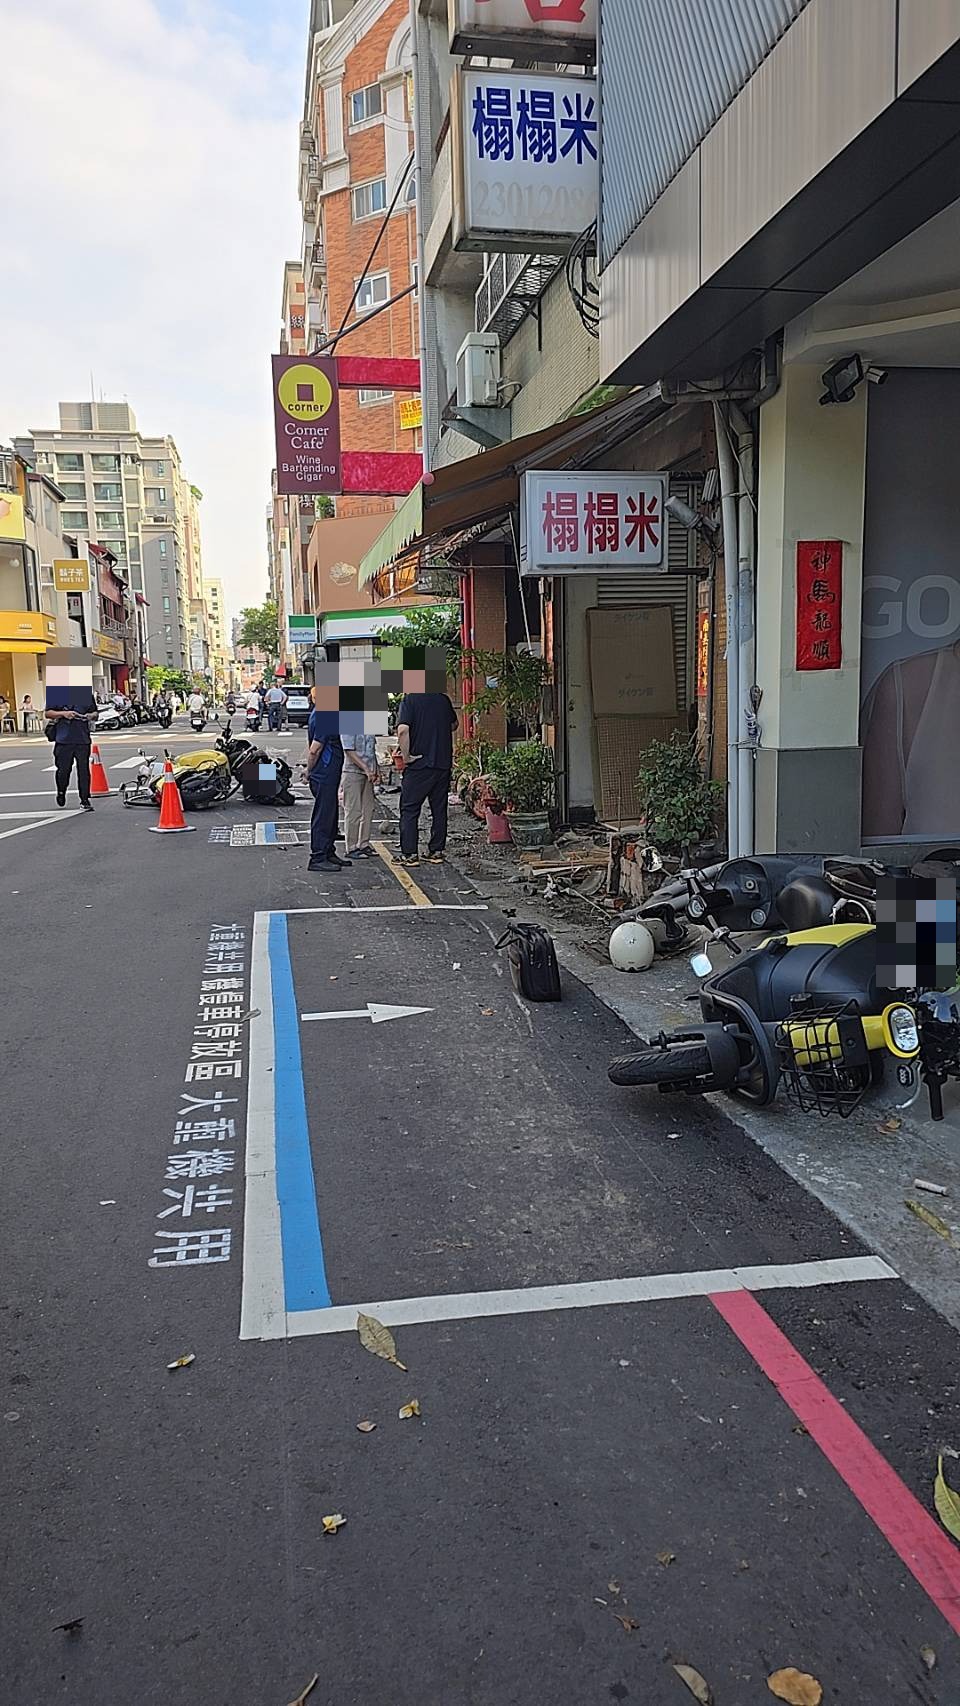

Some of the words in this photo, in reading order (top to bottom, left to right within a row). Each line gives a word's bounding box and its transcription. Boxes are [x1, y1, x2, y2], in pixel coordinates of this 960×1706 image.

[472, 86, 597, 164] 榻榻米
[288, 403, 324, 412] corner
[284, 423, 329, 436] Corner
[283, 464, 336, 474] Bartending
[296, 455, 320, 464] Wine
[296, 472, 323, 482] Cigar
[542, 491, 659, 553] 榻榻米
[202, 923, 245, 975] 大重機共用
[186, 977, 244, 1082] 機慢車停放區
[148, 1091, 238, 1267] 大重機共用
